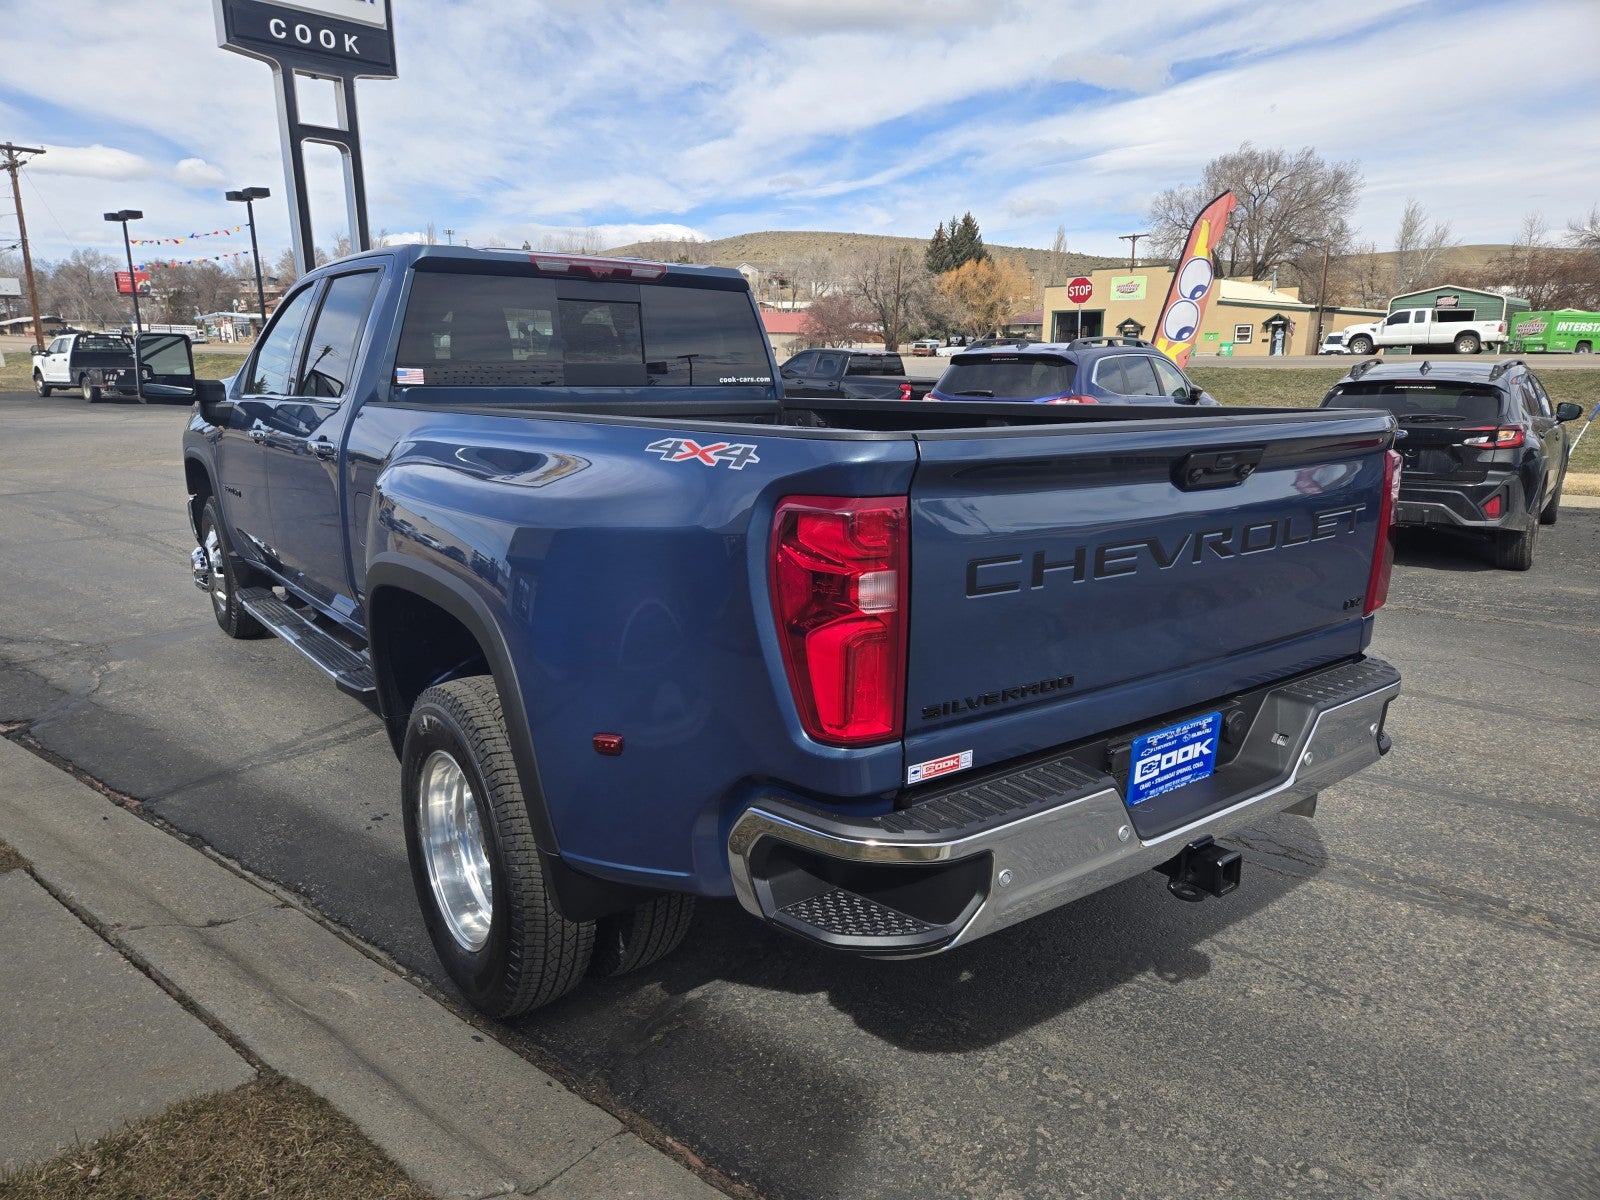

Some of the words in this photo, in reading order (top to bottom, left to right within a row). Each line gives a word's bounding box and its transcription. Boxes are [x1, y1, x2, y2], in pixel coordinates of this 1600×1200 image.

[269, 18, 360, 55] COOK
[1069, 285, 1091, 297] STOP
[966, 502, 1366, 599] CHEVROLET
[921, 674, 1075, 720] SILVERADO
[1191, 728, 1212, 739] SUBARU
[922, 758, 959, 774] COOK
[1134, 738, 1213, 784] COOK
